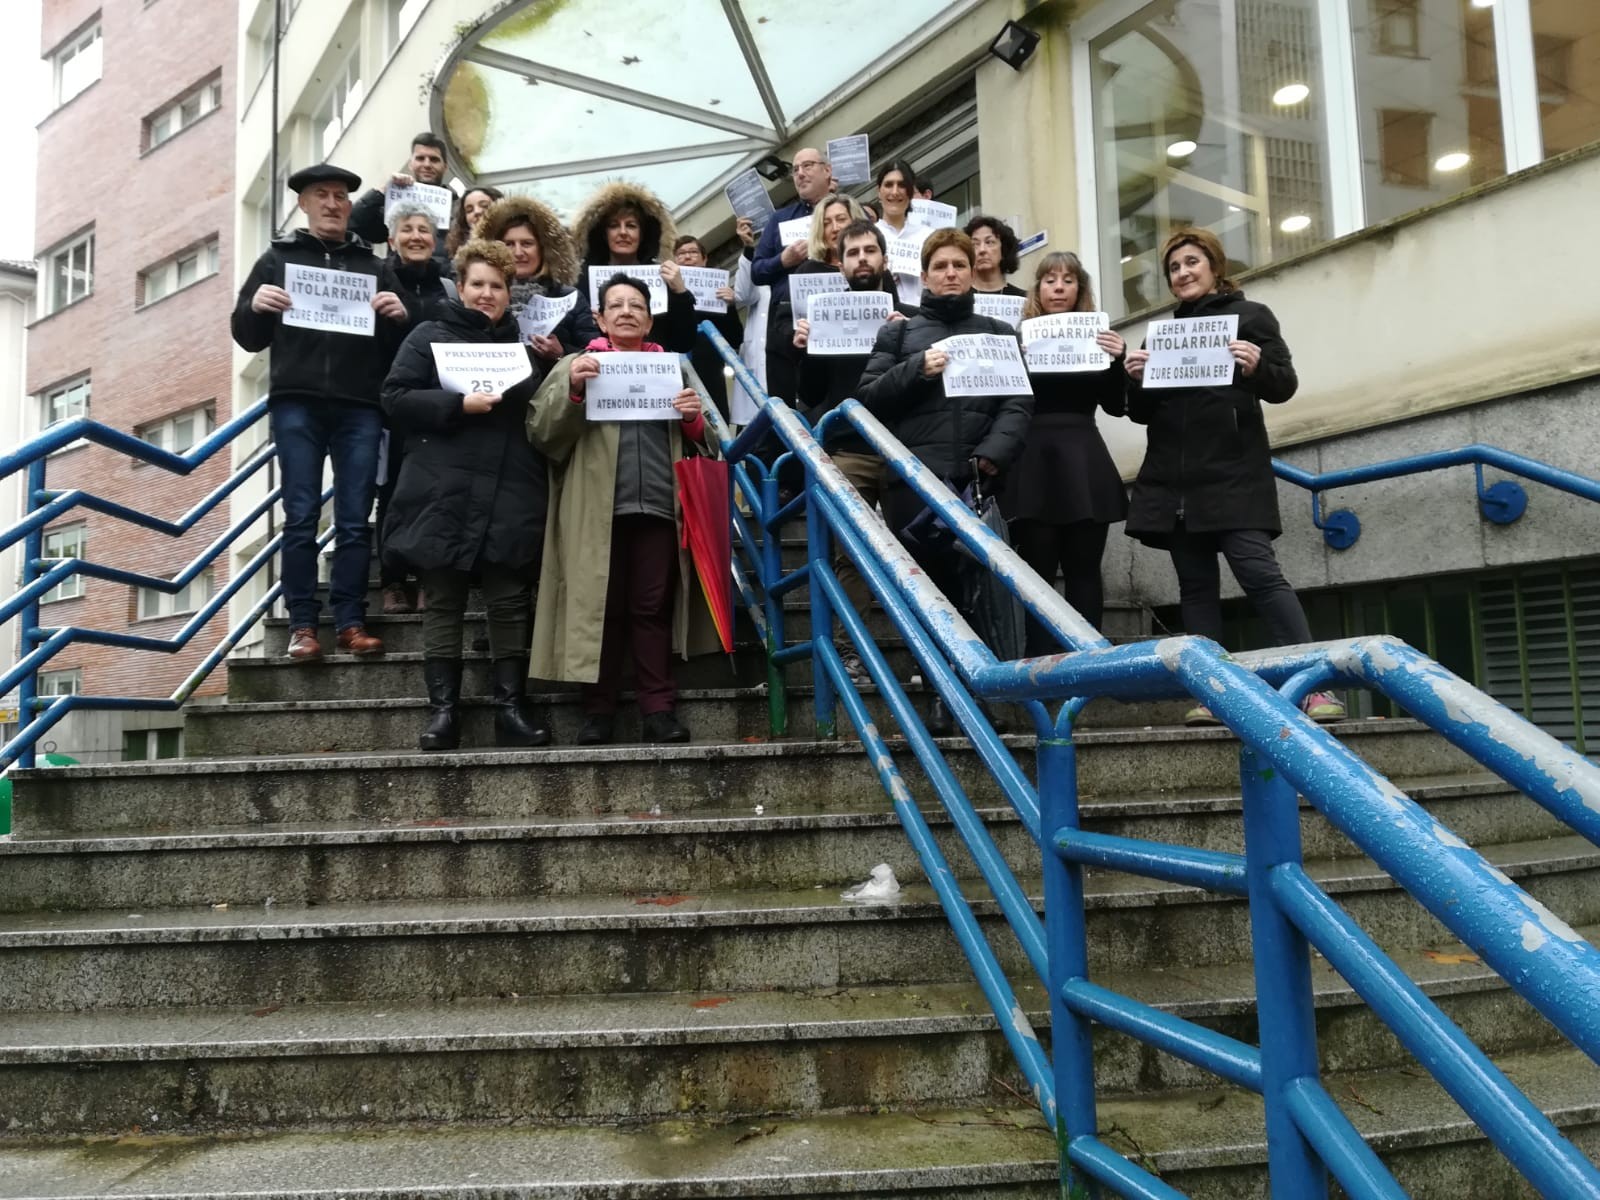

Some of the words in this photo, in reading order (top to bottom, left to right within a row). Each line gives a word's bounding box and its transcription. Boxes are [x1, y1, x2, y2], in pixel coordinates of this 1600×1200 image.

[390, 191, 402, 201] EN
[407, 193, 447, 206] PELIGRO
[296, 269, 327, 282] LEHEN
[333, 275, 369, 289] ARRETA
[799, 278, 823, 287] LEHEN
[292, 281, 371, 303] ITOLARRIAN
[853, 295, 888, 305] PRIMARIA
[289, 307, 312, 321] ZURE
[314, 311, 352, 327] OSASUNA
[353, 316, 369, 329] ERE
[814, 309, 829, 321] EN
[835, 308, 889, 321] PELIGRO
[1067, 316, 1101, 325] ARRETA
[1157, 323, 1186, 335] LEHEN
[1192, 320, 1229, 333] ARRETA
[827, 338, 852, 348] SALUD
[945, 337, 976, 348] LEHEN
[980, 338, 1013, 348] ARRETA
[1152, 334, 1232, 351] ITOLARRIAN
[445, 351, 516, 359] PRESUPUESTO
[1029, 353, 1049, 365] ZURE
[1051, 353, 1087, 365] OSASUNA
[1089, 353, 1104, 363] ERE
[636, 364, 648, 375] SIN
[650, 364, 676, 374] TIEMPO
[1150, 367, 1171, 380] ZURE
[1173, 366, 1212, 379] OSASUNA
[1213, 364, 1229, 377] ERE
[950, 376, 972, 389] ZURE
[974, 375, 1010, 388] OSASUNA
[1011, 376, 1026, 387] ERE
[597, 398, 636, 409] ATENCIÓN
[638, 399, 648, 409] DE
